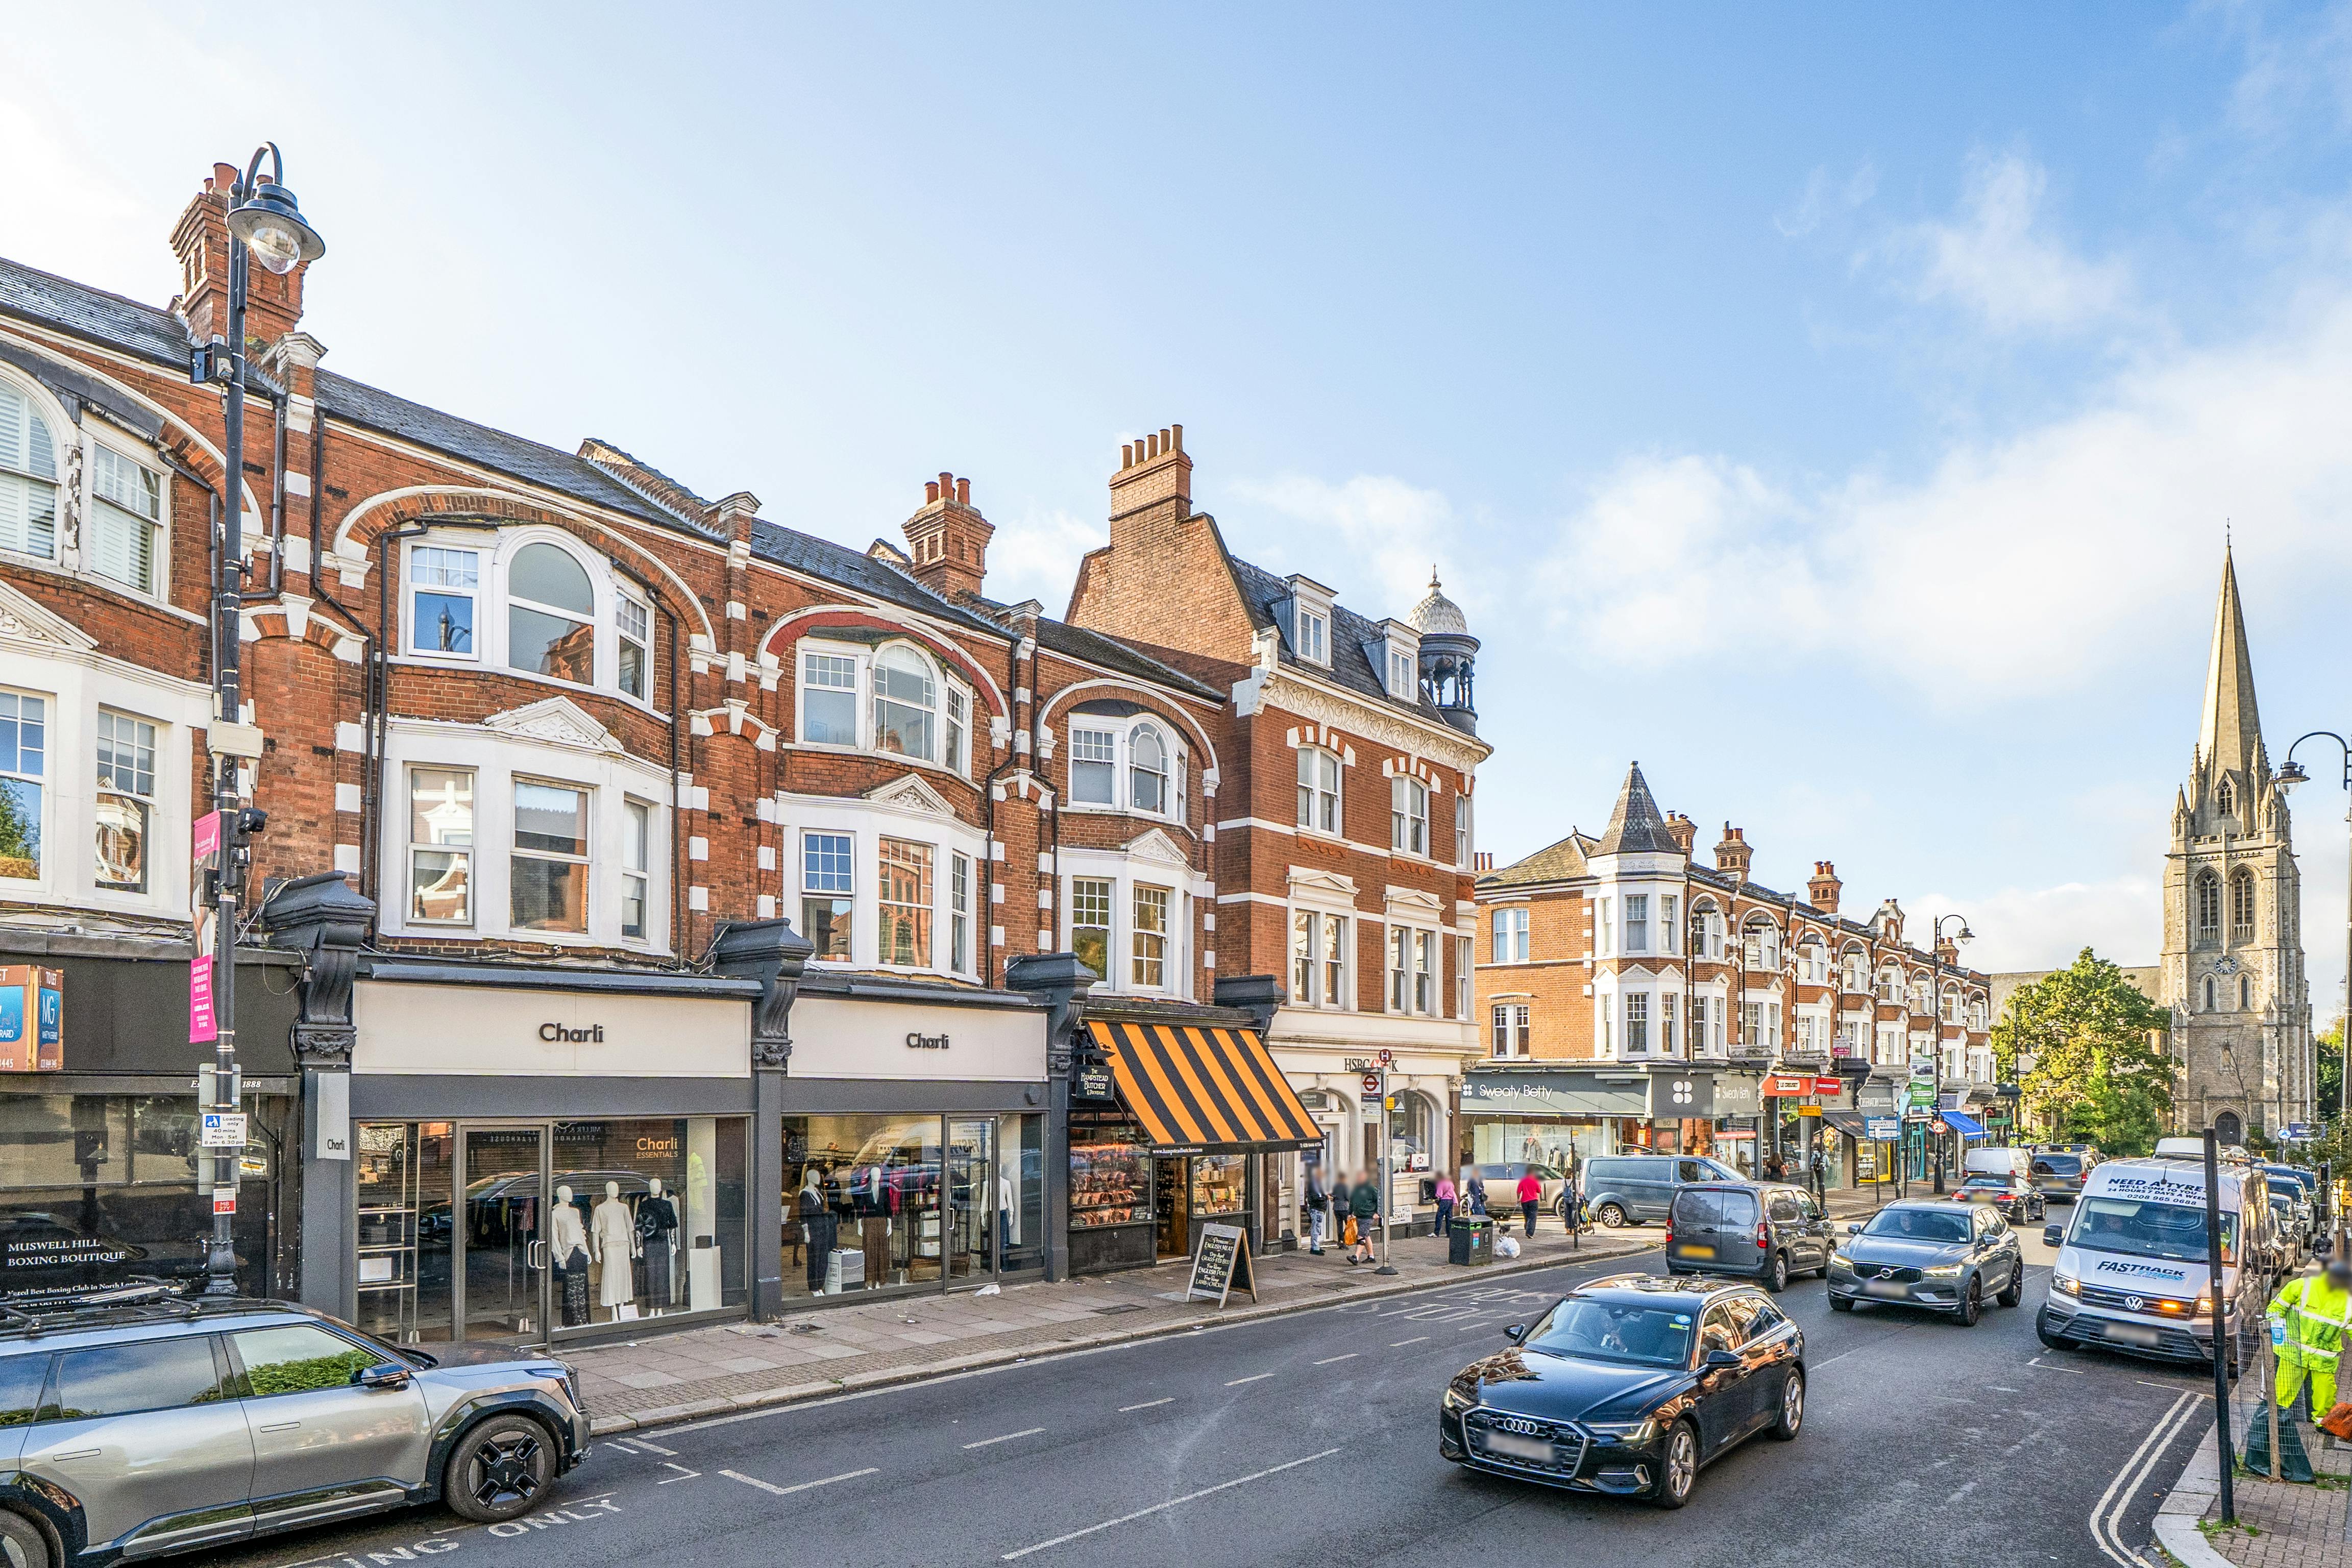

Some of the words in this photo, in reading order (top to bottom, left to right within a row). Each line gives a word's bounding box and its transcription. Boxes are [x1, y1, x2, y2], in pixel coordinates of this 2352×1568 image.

[42, 995, 55, 1025] MG
[0, 1030, 14, 1038] RARD
[538, 1022, 604, 1043] Charli
[906, 1033, 949, 1049] Charli
[1344, 1058, 1370, 1071] HSBC
[1081, 1072, 1109, 1082] HAMPSTEAD
[1084, 1081, 1106, 1090] BUTCHER
[1479, 1084, 1521, 1100] Sweaty
[1523, 1085, 1553, 1100] Betty
[1723, 1087, 1739, 1101] Sweaty
[1739, 1087, 1751, 1101] Betty
[327, 1139, 345, 1150] Charli
[636, 1137, 678, 1150] Charli
[1153, 1147, 1203, 1156] www.hampsteadbutcher.com
[8, 1241, 70, 1252] MUSWELL
[72, 1239, 100, 1248] HILL
[1204, 1241, 1222, 1250] ENGLISH
[8, 1256, 58, 1266] BOXING
[61, 1251, 126, 1263] BOUTIQUE
[1198, 1266, 1217, 1275] ENGLISH
[2097, 1261, 2186, 1276] FASTRACK
[487, 1499, 623, 1537] ONLY
